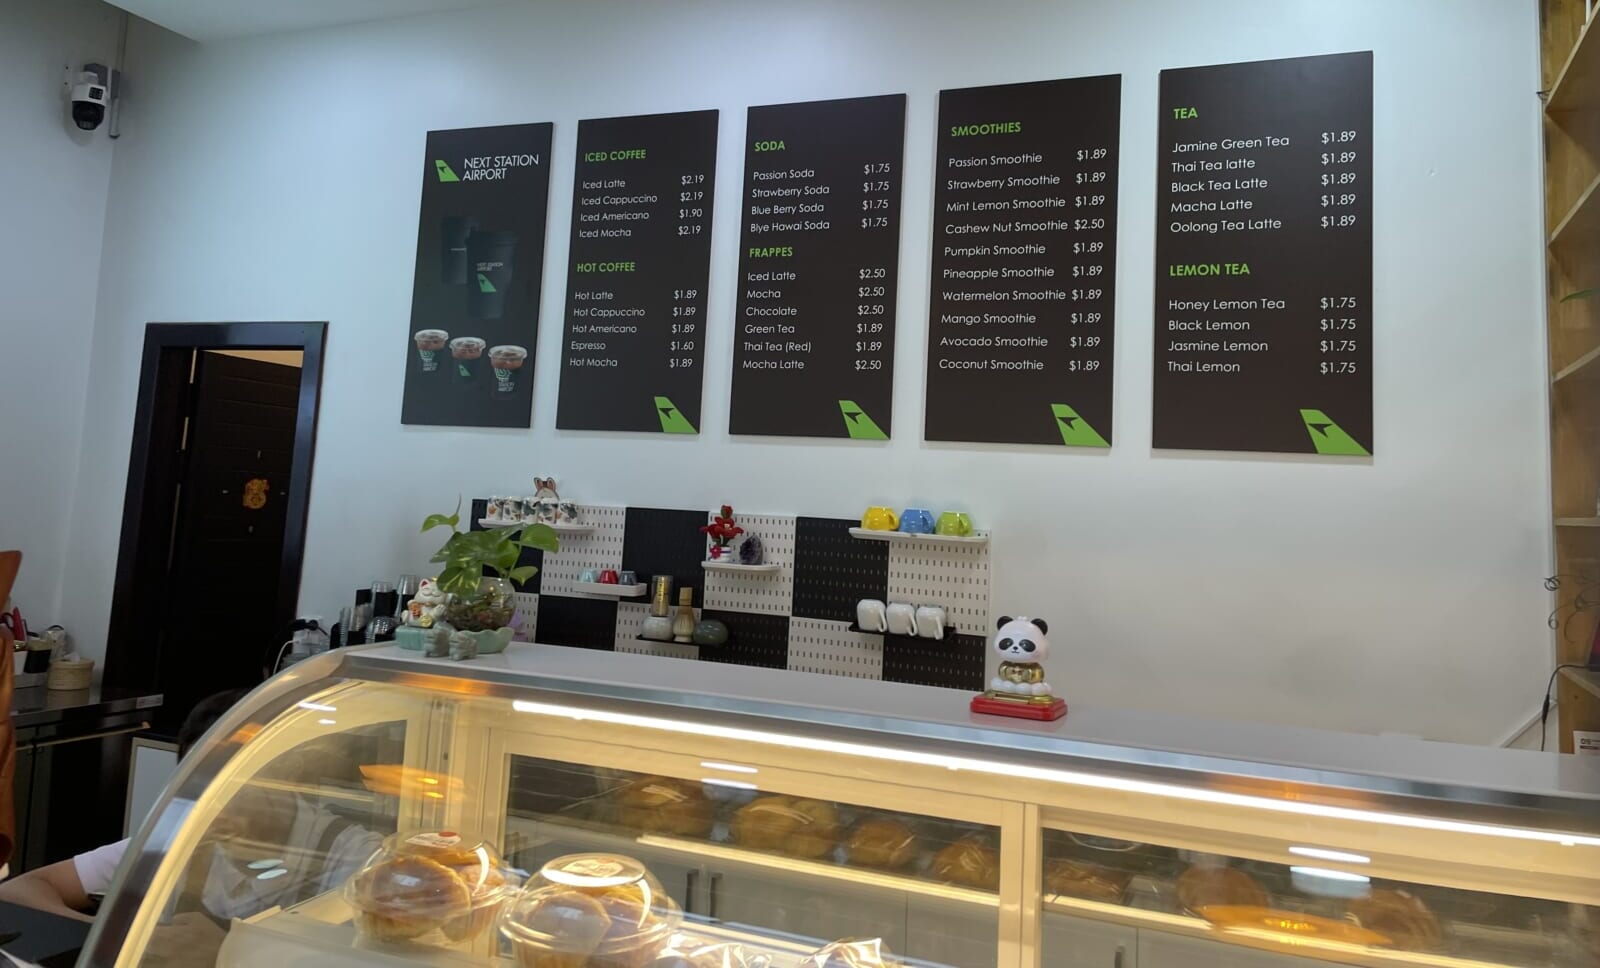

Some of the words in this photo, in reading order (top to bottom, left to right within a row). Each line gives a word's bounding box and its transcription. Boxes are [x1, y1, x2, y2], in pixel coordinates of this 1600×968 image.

[1173, 107, 1198, 119] TEA
[951, 122, 1021, 137] SMOOTHIES
[755, 140, 785, 152] SODA
[1172, 141, 1218, 153] Jamine
[1221, 139, 1262, 150] Green
[1265, 136, 1289, 147] Tea
[1321, 130, 1356, 145] $1.89
[464, 156, 492, 169] NEXT
[494, 154, 539, 168] STATION
[585, 152, 607, 162] ICED
[610, 149, 646, 161] COFFEE
[949, 157, 988, 167] Passion
[990, 153, 1042, 165] Smoothie
[1077, 148, 1107, 161] $1.89
[1172, 161, 1196, 172] Thai
[1200, 161, 1222, 171] Tea
[1226, 158, 1256, 169] latte
[1321, 151, 1356, 166] $1.89
[462, 168, 507, 181] AIRPORT
[753, 170, 787, 180] Passion
[789, 168, 815, 178] Soda
[864, 163, 890, 175] $1.75
[583, 180, 602, 189] Iced
[604, 179, 626, 188] Latte
[681, 174, 704, 186] $2.19
[947, 179, 1005, 190] Strawberry
[1007, 174, 1060, 187] Smoothie
[1076, 172, 1106, 184] $1.89
[1172, 181, 1205, 192] Black
[1208, 180, 1231, 190] Tea
[1235, 178, 1268, 189] Latte
[1321, 172, 1356, 186] $1.89
[752, 188, 802, 198] Strawberry
[804, 185, 830, 195] Soda
[863, 181, 889, 193] $1.75
[581, 196, 601, 206] Iced
[602, 194, 658, 206] Cappuccino
[680, 191, 703, 202] $2.19
[946, 202, 969, 212] Mint
[972, 201, 1010, 211] Lemon
[1012, 197, 1066, 209] Smoothie
[1075, 195, 1105, 208] $1.89
[1171, 201, 1216, 212] Macha
[1220, 199, 1253, 210] Latte
[1321, 194, 1356, 208] $1.89
[751, 206, 771, 215] Blue
[773, 205, 797, 215] Berry
[799, 203, 824, 213] Soda
[862, 199, 888, 211] $1.75
[580, 213, 600, 222] Iced
[601, 211, 650, 221] Americano
[679, 208, 703, 219] $1.90
[750, 223, 770, 234] Blye
[772, 221, 802, 231] Hawai
[804, 220, 830, 230] Soda
[861, 217, 888, 229] $1.75
[945, 224, 990, 234] Cashew
[993, 222, 1012, 232] Nut
[1014, 220, 1068, 232] Smoothie
[1074, 218, 1105, 231] $2.50
[1170, 221, 1218, 233] Oolong
[1221, 220, 1244, 230] Tea
[1248, 218, 1282, 230] Latte
[1321, 215, 1356, 229] $1.89
[579, 229, 599, 238] Iced
[600, 228, 631, 237] Mocha
[678, 225, 701, 236] $2.19
[749, 246, 793, 258] FRAPPES
[944, 245, 990, 257] Pumpkin
[993, 244, 1046, 255] Smoothie
[1073, 242, 1103, 254] $1.89
[577, 263, 597, 272] HOT
[598, 262, 635, 272] COFFEE
[943, 268, 999, 280] Pineapple
[1001, 266, 1055, 278] Smoothie
[1072, 265, 1103, 278] $1.89
[1170, 264, 1220, 276] LEMON
[1225, 263, 1250, 275] TEA
[748, 272, 769, 281] Iced
[772, 272, 796, 281] Latte
[859, 268, 886, 280] $2.50
[575, 292, 590, 300] Hot
[591, 291, 613, 300] Latte
[674, 290, 697, 300] $1.89
[746, 289, 781, 298] Mocha
[858, 286, 885, 298] $2.50
[942, 291, 1009, 301] Watermelon
[1012, 289, 1066, 300] Smoothie
[1072, 289, 1102, 301] $1.89
[746, 307, 797, 316] Chocolate
[857, 305, 884, 316] $2.50
[1169, 300, 1210, 312] Honey
[1213, 299, 1257, 310] Lemon
[1261, 298, 1285, 309] Tea
[1320, 297, 1356, 310] $1.75
[573, 308, 588, 317] Hot
[590, 307, 645, 318] Cappuccino
[673, 307, 696, 317] $1.89
[941, 314, 981, 326] Mango
[983, 313, 1036, 323] Smoothie
[1071, 313, 1101, 324] $1.89
[1169, 320, 1202, 330] Black
[1206, 320, 1250, 330] Lemon
[1320, 318, 1356, 332] $1.75
[572, 325, 587, 333] Hot
[589, 324, 637, 333] Americano
[672, 324, 695, 334] $1.89
[745, 324, 775, 334] Green
[777, 324, 795, 333] Tea
[857, 323, 883, 334] $1.89
[571, 341, 606, 351] Espresso
[670, 341, 694, 351] $1.60
[744, 342, 763, 351] Thai
[765, 342, 782, 351] Tea
[785, 342, 811, 353] (Red)
[856, 341, 882, 352] $1.89
[940, 337, 992, 346] Avocado
[994, 336, 1048, 347] Smoothie
[1070, 336, 1101, 348] $1.89
[1168, 340, 1220, 351] Jasmine
[1224, 341, 1268, 351] Lemon
[1320, 340, 1356, 353] $1.75
[569, 358, 585, 366] Hot
[586, 358, 618, 367] Mocha
[670, 358, 693, 368] $1.89
[743, 360, 777, 369] Mocha
[780, 360, 804, 369] Latte
[855, 360, 882, 371] $2.50
[939, 359, 988, 369] Coconut
[990, 359, 1044, 370] Smoothie
[1069, 360, 1100, 372] $1.89
[1167, 361, 1193, 372] Thai
[1196, 361, 1240, 372] Lemon
[1320, 362, 1356, 375] $1.75
